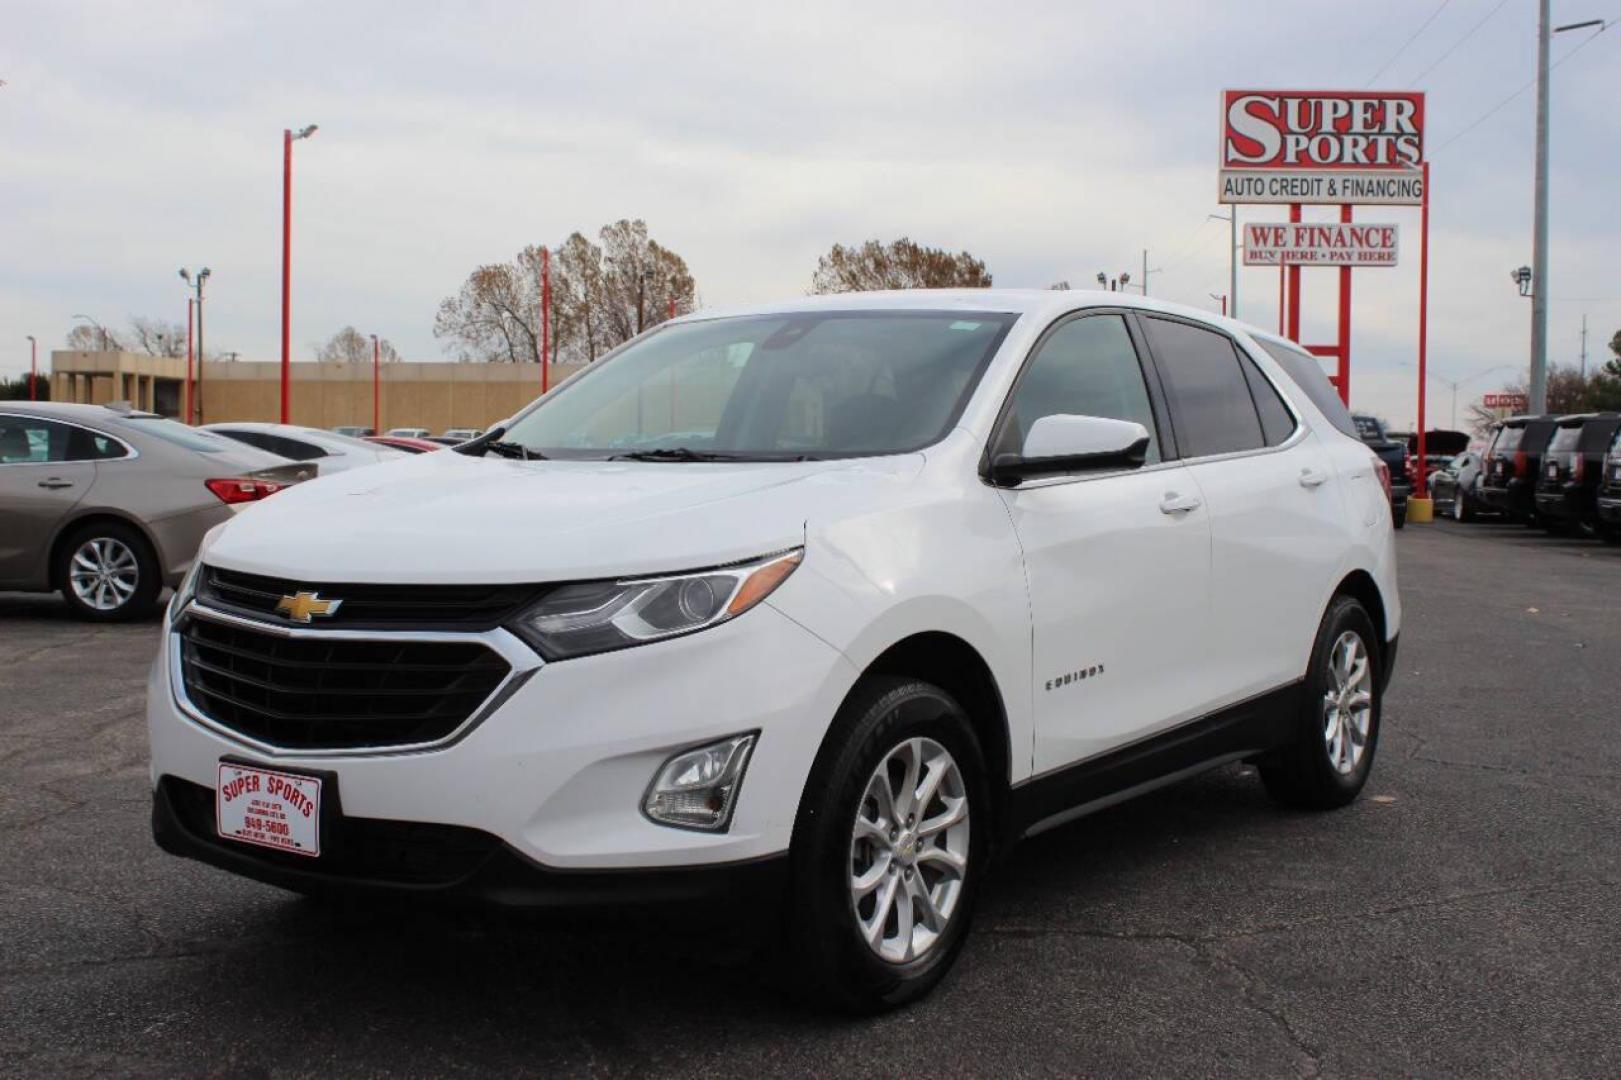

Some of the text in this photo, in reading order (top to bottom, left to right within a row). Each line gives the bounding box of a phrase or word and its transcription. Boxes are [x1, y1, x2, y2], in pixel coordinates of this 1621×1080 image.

[1227, 95, 1417, 163] SUPER
[1224, 177, 1423, 198] AUTO CREDIT & FINANCING
[1250, 226, 1395, 249] WE FINANCE
[1250, 250, 1396, 261] BUY HERE PAY HERE
[1045, 664, 1104, 691] EQUINOX
[222, 774, 314, 818] SUPER SPORTS
